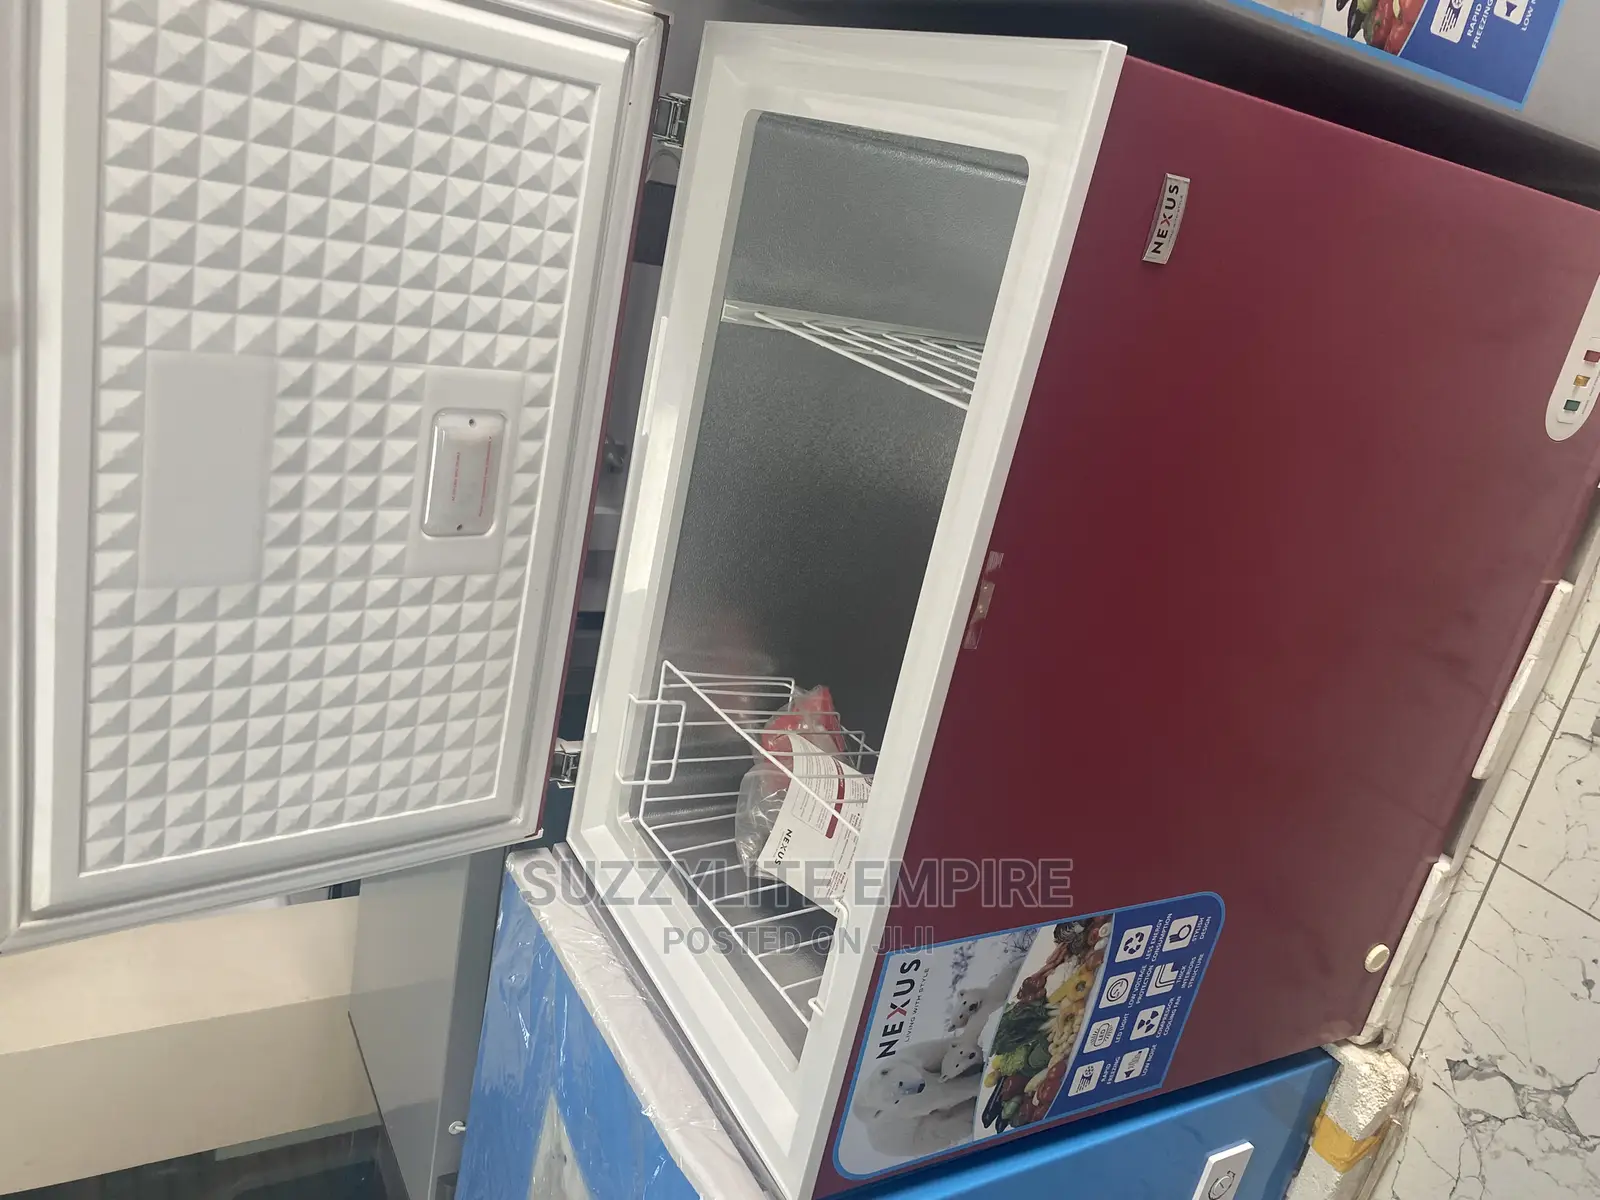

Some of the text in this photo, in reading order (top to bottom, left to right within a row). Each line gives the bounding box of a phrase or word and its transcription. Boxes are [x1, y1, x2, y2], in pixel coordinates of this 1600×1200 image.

[1467, 3, 1482, 37] RAPID
[1472, 0, 1493, 49] FREEZING
[1521, 6, 1534, 31] LOW
[1151, 184, 1179, 254] NEXUS
[774, 828, 793, 866] NEXUS
[1152, 913, 1173, 962] CONSUMPTION
[1191, 917, 1205, 942] STYLISH
[1199, 916, 1212, 940] DESIGN
[904, 967, 931, 1043] LIVING WITH STYLE
[1128, 964, 1147, 1009] LOW VOLTAGE
[1136, 964, 1154, 1005] PROTECTION
[876, 958, 921, 1060] NEXUS
[1115, 1013, 1130, 1044] LED LIGHT
[1156, 997, 1174, 1038] COMPRESSOR
